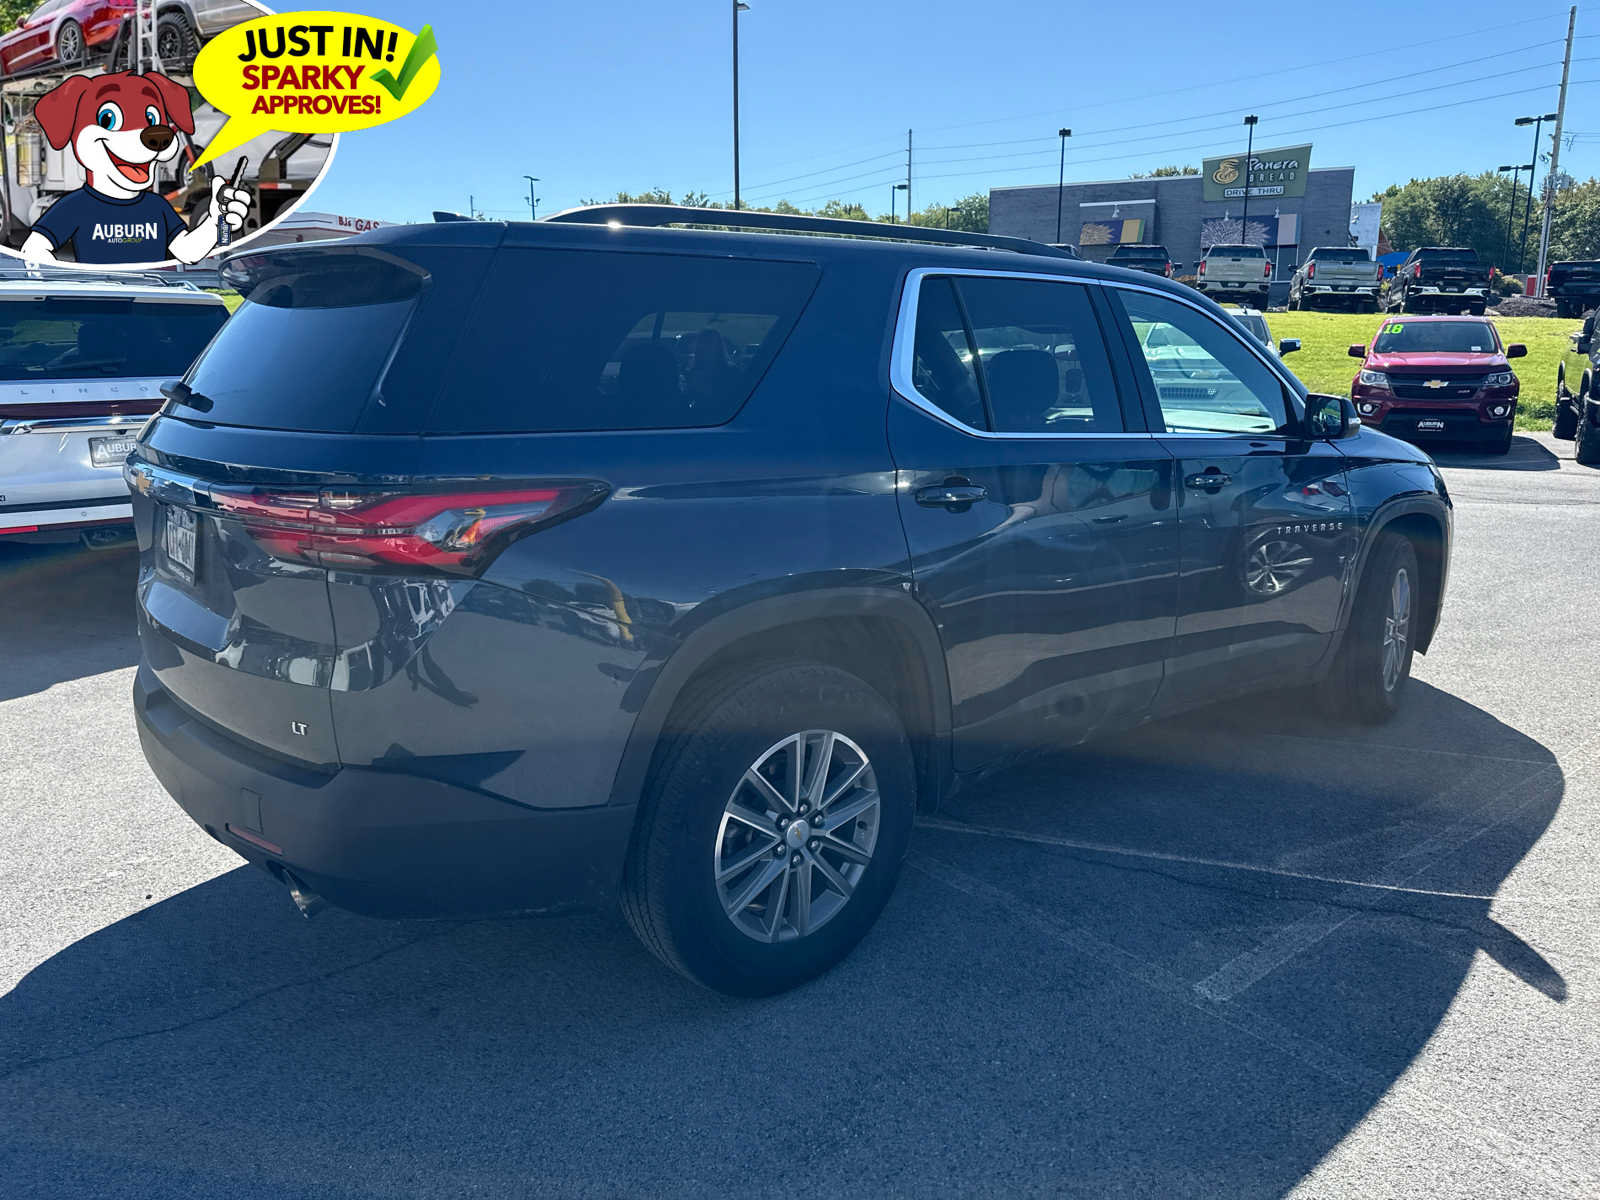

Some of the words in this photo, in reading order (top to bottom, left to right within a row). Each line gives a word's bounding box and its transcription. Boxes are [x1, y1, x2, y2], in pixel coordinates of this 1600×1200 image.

[1245, 158, 1299, 171] Panera
[1249, 172, 1295, 183] BREAD
[1258, 187, 1282, 195] THRU
[1383, 324, 1404, 335] 18
[95, 442, 137, 459] AUBUR
[1277, 522, 1343, 535] TRAVERSE
[292, 721, 308, 736] LT
